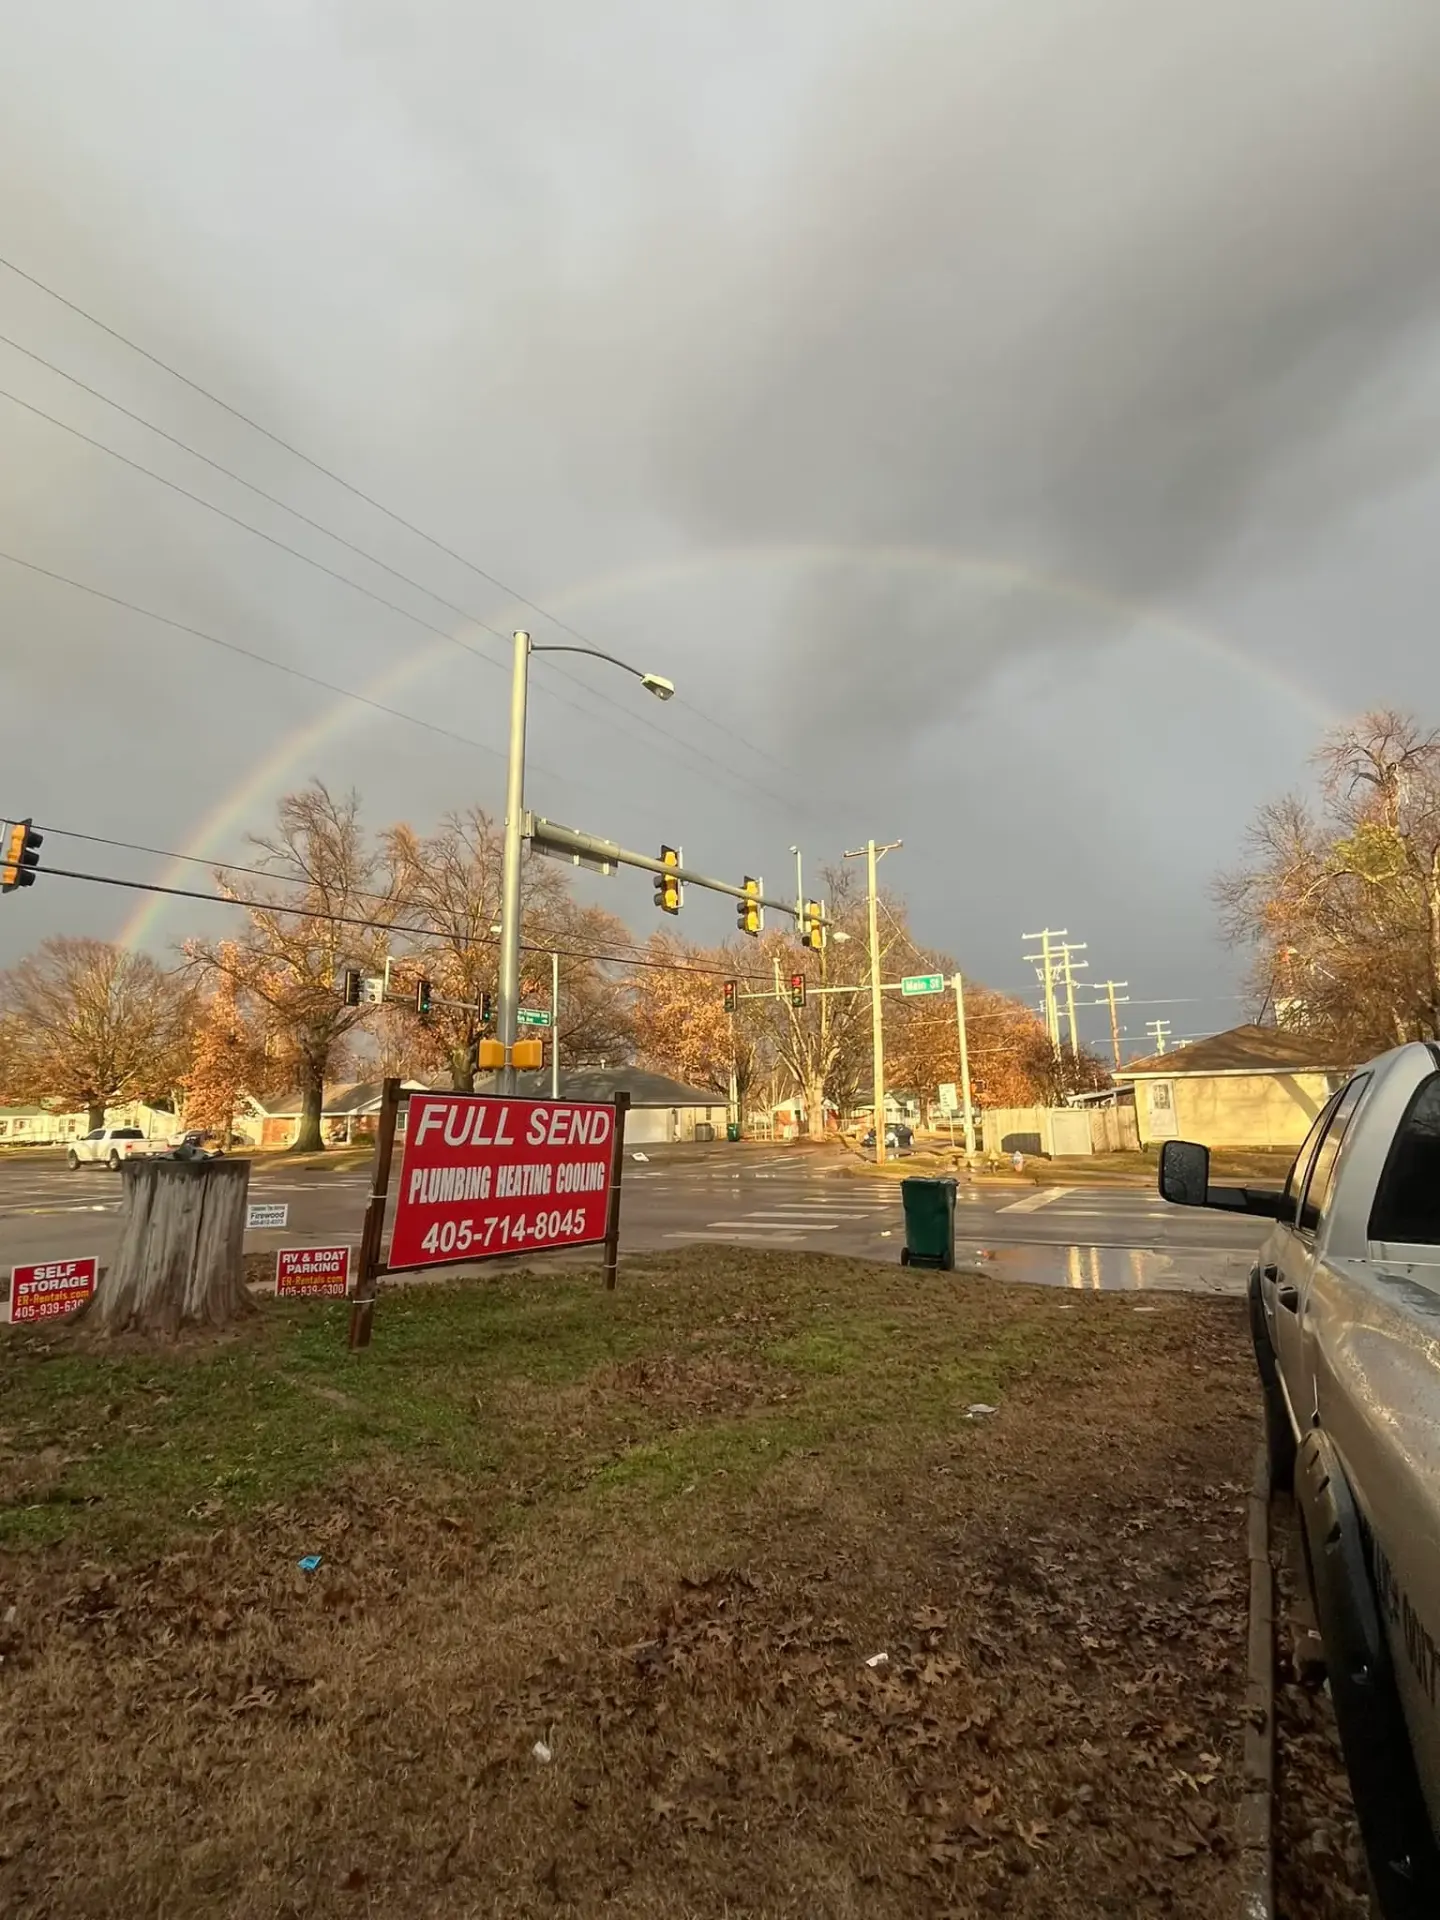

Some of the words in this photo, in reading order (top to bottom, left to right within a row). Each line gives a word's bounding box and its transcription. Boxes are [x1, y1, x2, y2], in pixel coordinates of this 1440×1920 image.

[414, 1104, 515, 1147] FULL
[526, 1107, 610, 1146] SEND
[408, 1165, 492, 1205] PLUMBING
[495, 1163, 552, 1198] HEATING
[556, 1162, 606, 1194] COOLING
[421, 1208, 587, 1254] 405-714-8045
[282, 1253, 299, 1264] RV
[301, 1253, 311, 1262] &
[314, 1251, 346, 1262] BOAT
[33, 1264, 76, 1280] SELF
[286, 1262, 340, 1274] PARKING
[19, 1276, 89, 1294] STORAGE
[281, 1275, 344, 1286] ER-Rentals.com
[17, 1289, 89, 1306] ER-Rentals.com
[15, 1299, 84, 1318] 405-939-630
